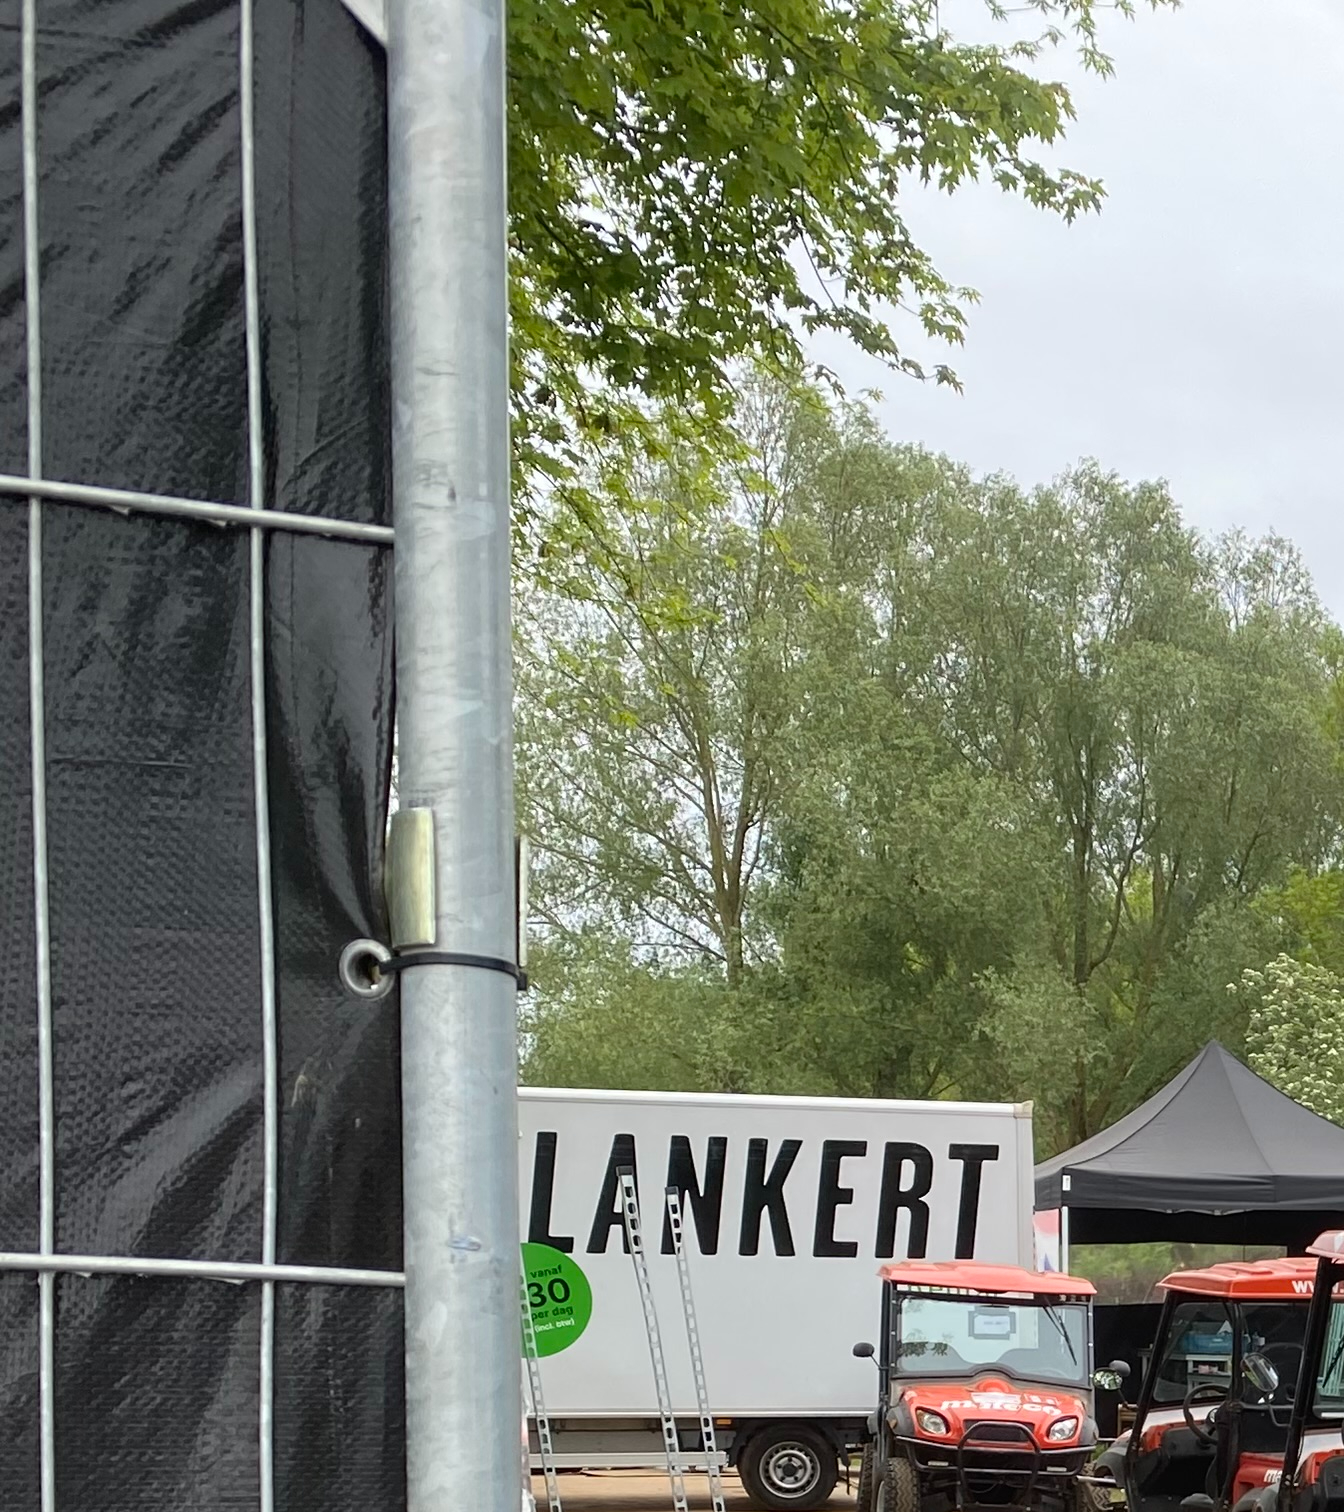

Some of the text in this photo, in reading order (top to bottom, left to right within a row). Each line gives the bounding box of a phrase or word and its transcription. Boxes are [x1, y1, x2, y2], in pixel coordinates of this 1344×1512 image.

[529, 1132, 999, 1259] LANKERT
[530, 1264, 562, 1279] vanaf
[527, 1278, 571, 1308] 30
[531, 1306, 574, 1322] per dag
